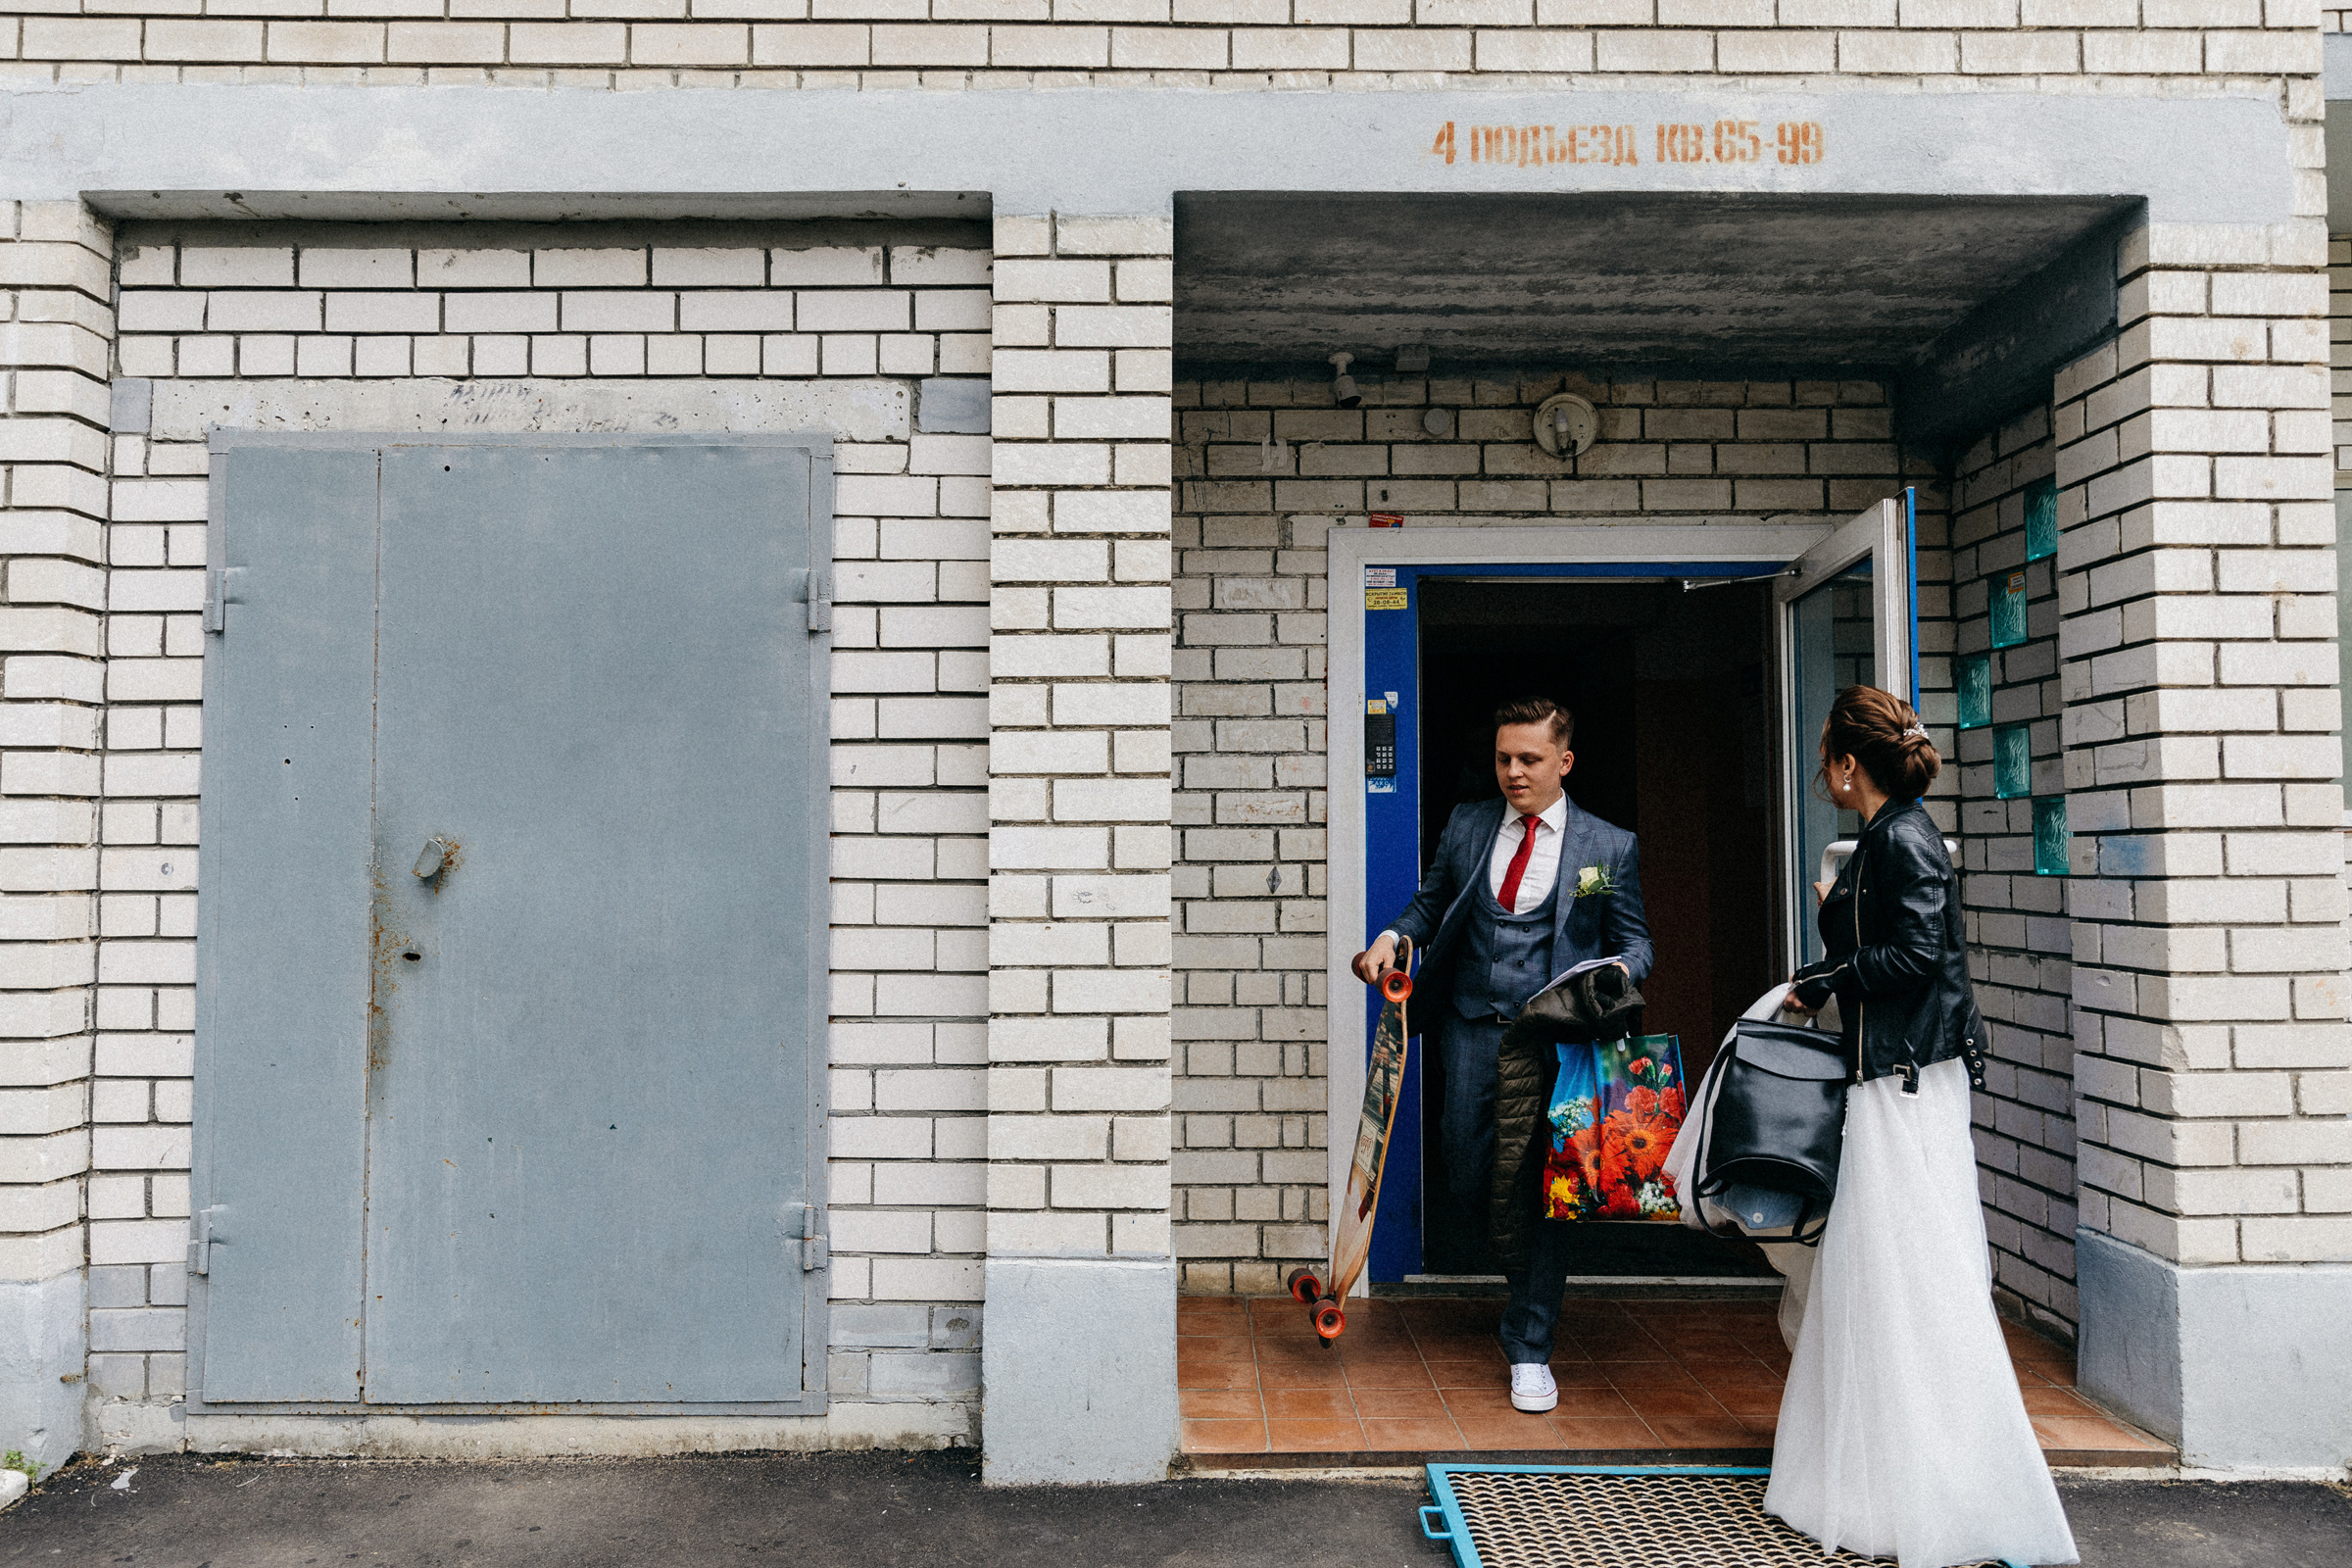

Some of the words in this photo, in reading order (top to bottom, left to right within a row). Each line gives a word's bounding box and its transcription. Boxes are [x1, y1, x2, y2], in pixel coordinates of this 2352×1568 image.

[1431, 121, 1457, 165] 4
[1470, 124, 1639, 168] ПОДЪЕЗД
[1656, 120, 1825, 165] КВ.65-99
